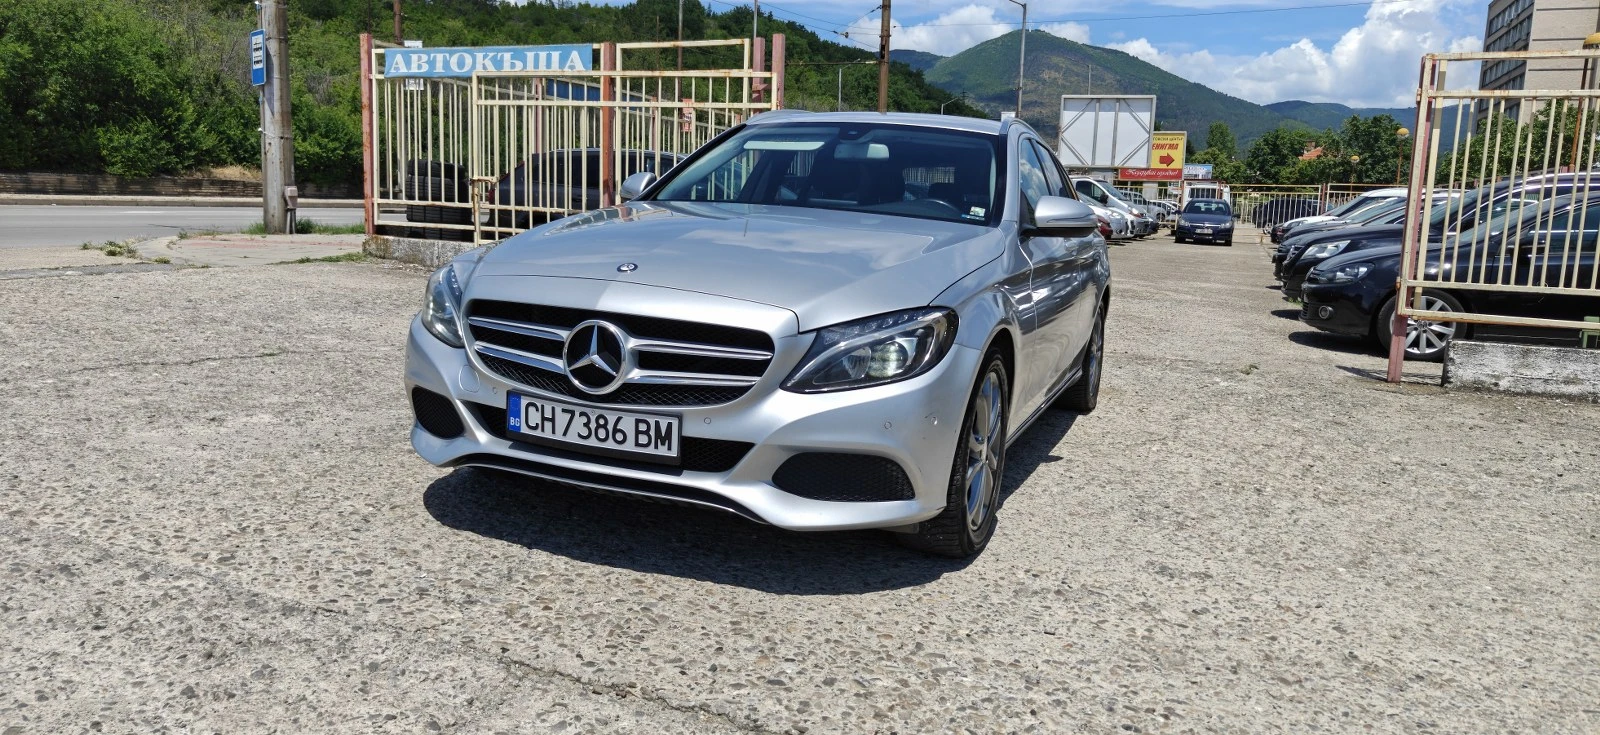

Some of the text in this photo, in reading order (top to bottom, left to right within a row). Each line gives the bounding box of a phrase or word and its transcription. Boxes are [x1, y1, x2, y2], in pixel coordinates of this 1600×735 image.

[1151, 143, 1179, 151] ЕНИГМА
[509, 416, 521, 427] BG
[524, 401, 673, 451] CH 7386 BM
